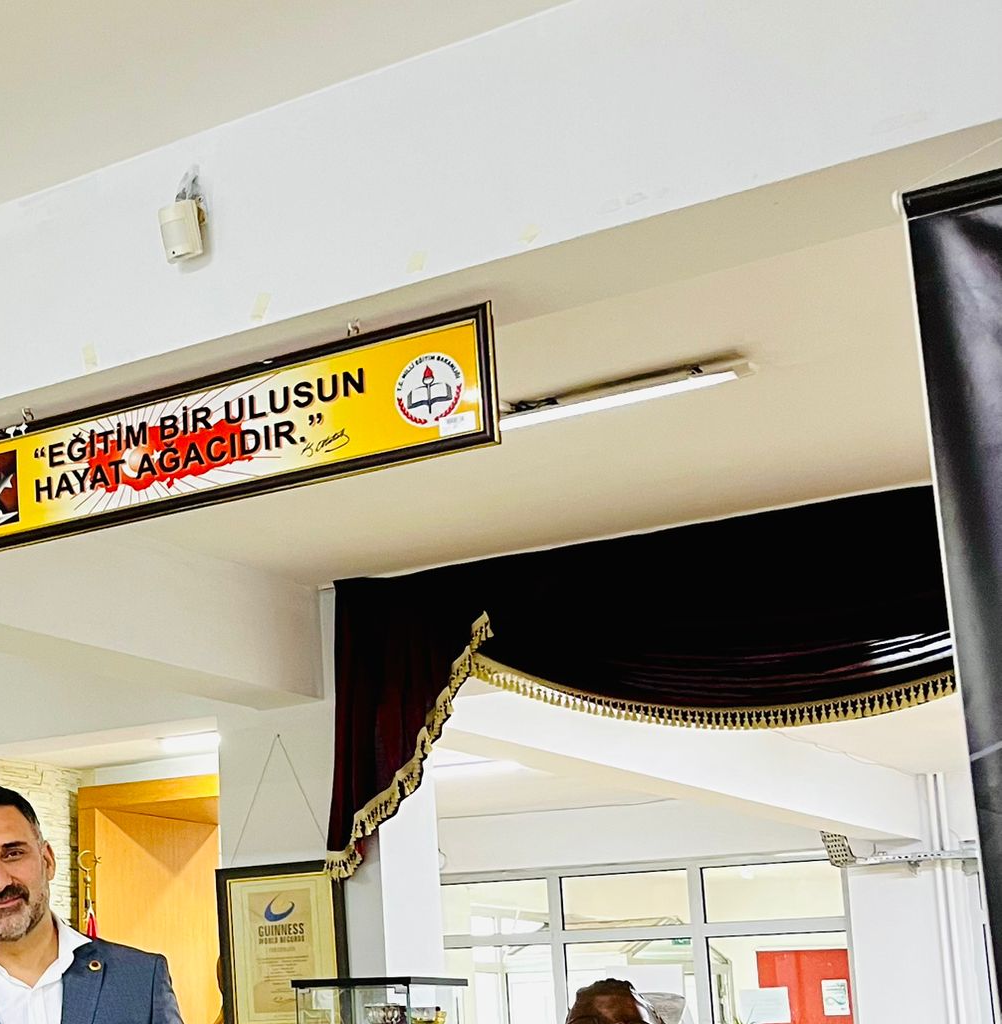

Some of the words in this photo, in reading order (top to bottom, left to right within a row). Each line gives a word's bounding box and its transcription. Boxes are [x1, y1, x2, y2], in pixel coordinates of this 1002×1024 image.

[160, 405, 212, 441] BİR
[224, 367, 365, 425] ULUSUN
[35, 459, 126, 503] HAYAT
[258, 922, 305, 937] GUINNESS
